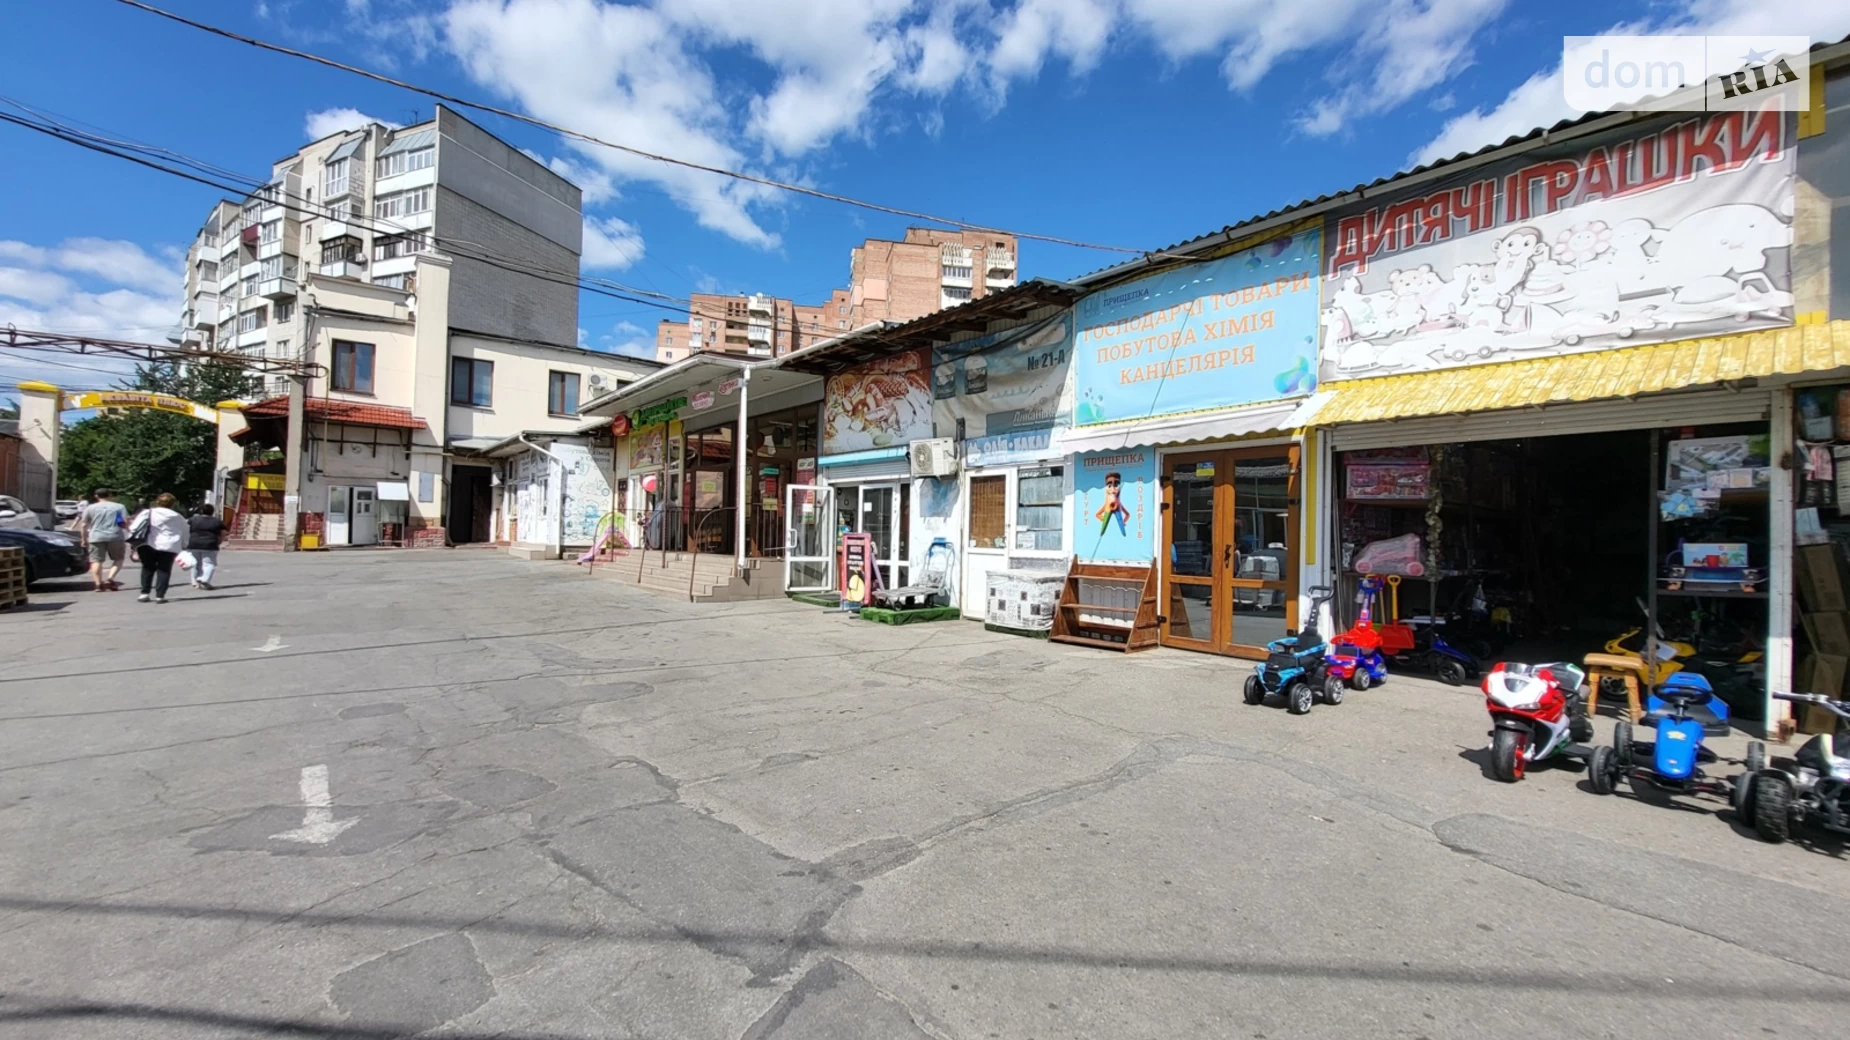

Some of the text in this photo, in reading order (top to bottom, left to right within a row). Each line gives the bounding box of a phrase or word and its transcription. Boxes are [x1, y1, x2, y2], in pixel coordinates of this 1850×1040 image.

[1328, 93, 1786, 281] ДИТЯЧІ ІГРАШКИ
[1084, 271, 1310, 342] ГОСПОДАРЧІ ТОВАРИ
[1103, 287, 1149, 307] ПРИЩЕПКА
[1097, 309, 1275, 364] ПОБУТОВА ХІМІЯ
[1119, 345, 1256, 384] КАНЦЕЛЯРІЯ
[1083, 453, 1145, 467] ПРИЩЕПКА
